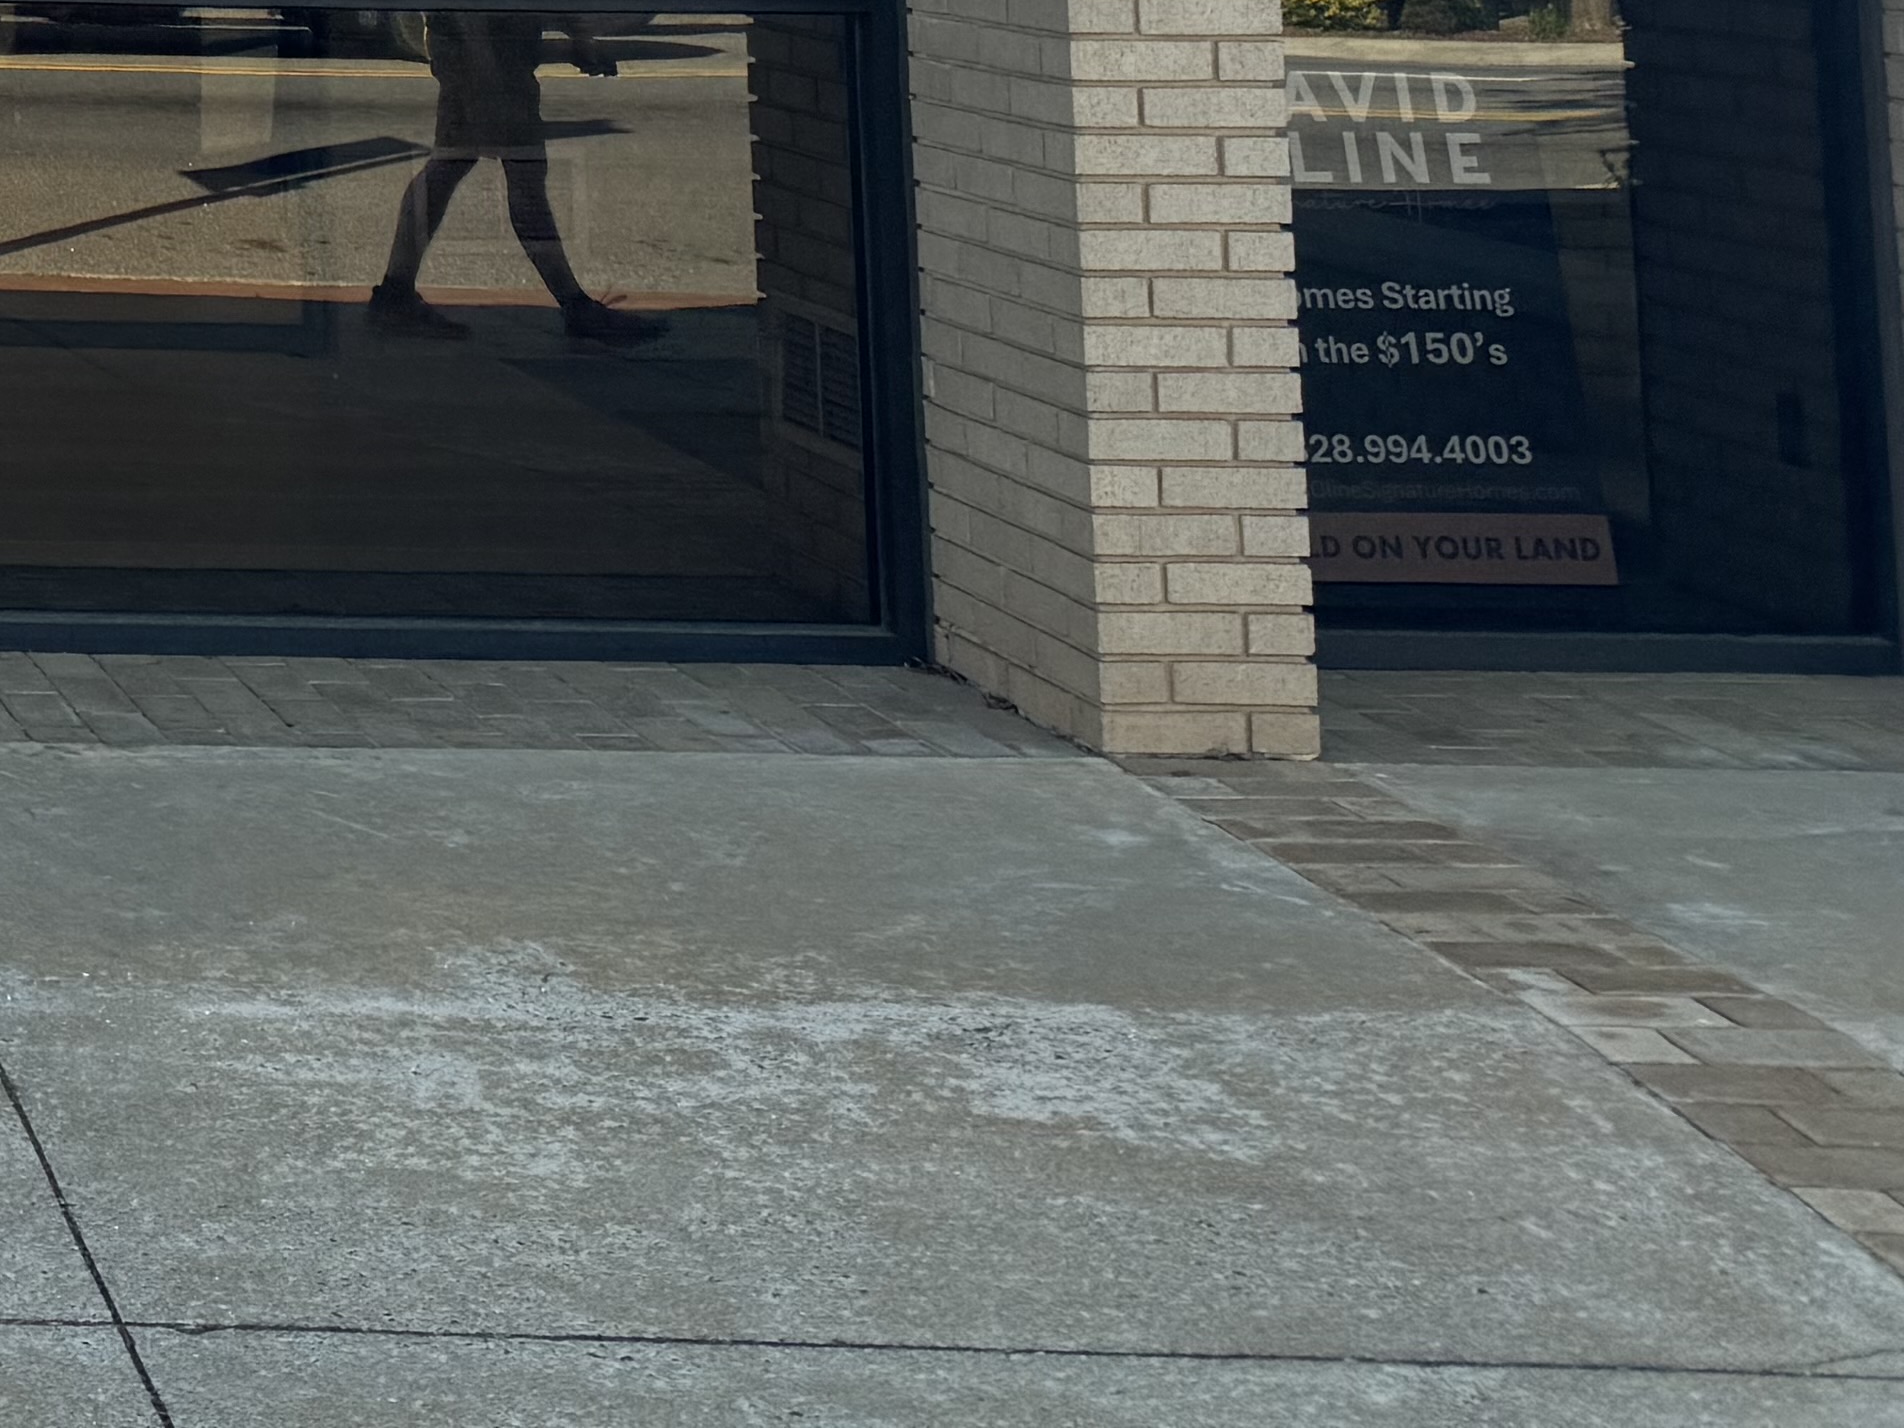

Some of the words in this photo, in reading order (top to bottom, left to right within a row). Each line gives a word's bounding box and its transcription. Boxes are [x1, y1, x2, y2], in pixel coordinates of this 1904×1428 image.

[1284, 71, 1477, 123] AVID
[1288, 131, 1491, 184] LINE
[1297, 288, 1375, 310] mes
[1381, 281, 1515, 317] Starting
[1314, 336, 1370, 364] the
[1303, 434, 1533, 465] 28.994.4003
[1353, 536, 1403, 559] ON
[1411, 536, 1504, 560] YOUR
[1515, 537, 1600, 561] LAND
